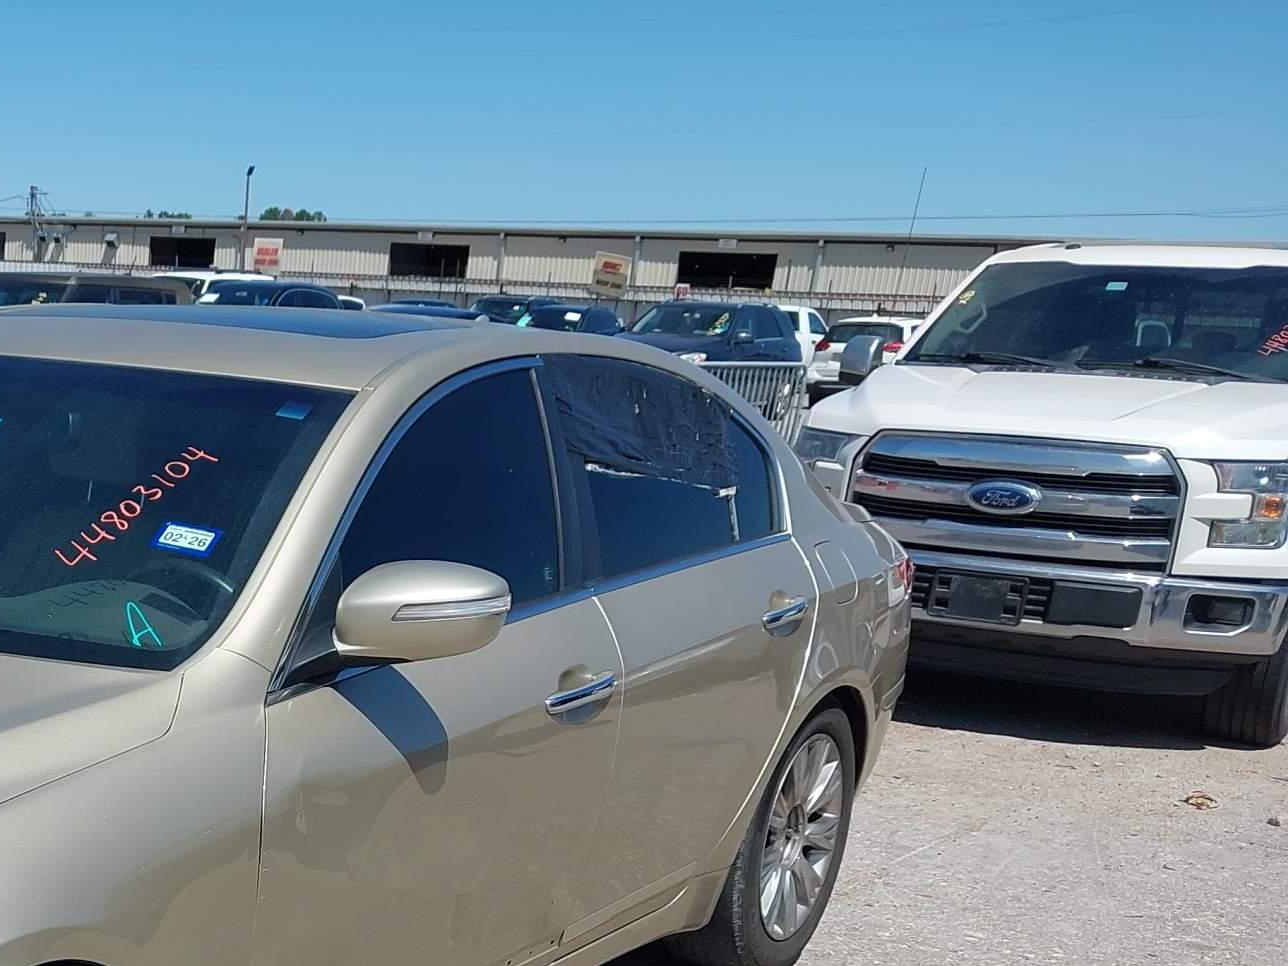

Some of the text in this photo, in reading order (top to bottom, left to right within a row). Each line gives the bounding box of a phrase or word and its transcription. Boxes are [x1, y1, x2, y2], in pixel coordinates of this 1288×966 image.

[54, 446, 219, 566] 44803104
[981, 489, 1021, 507] Ford
[163, 531, 183, 543] 02
[187, 536, 209, 548] 26
[125, 601, 162, 648] A
